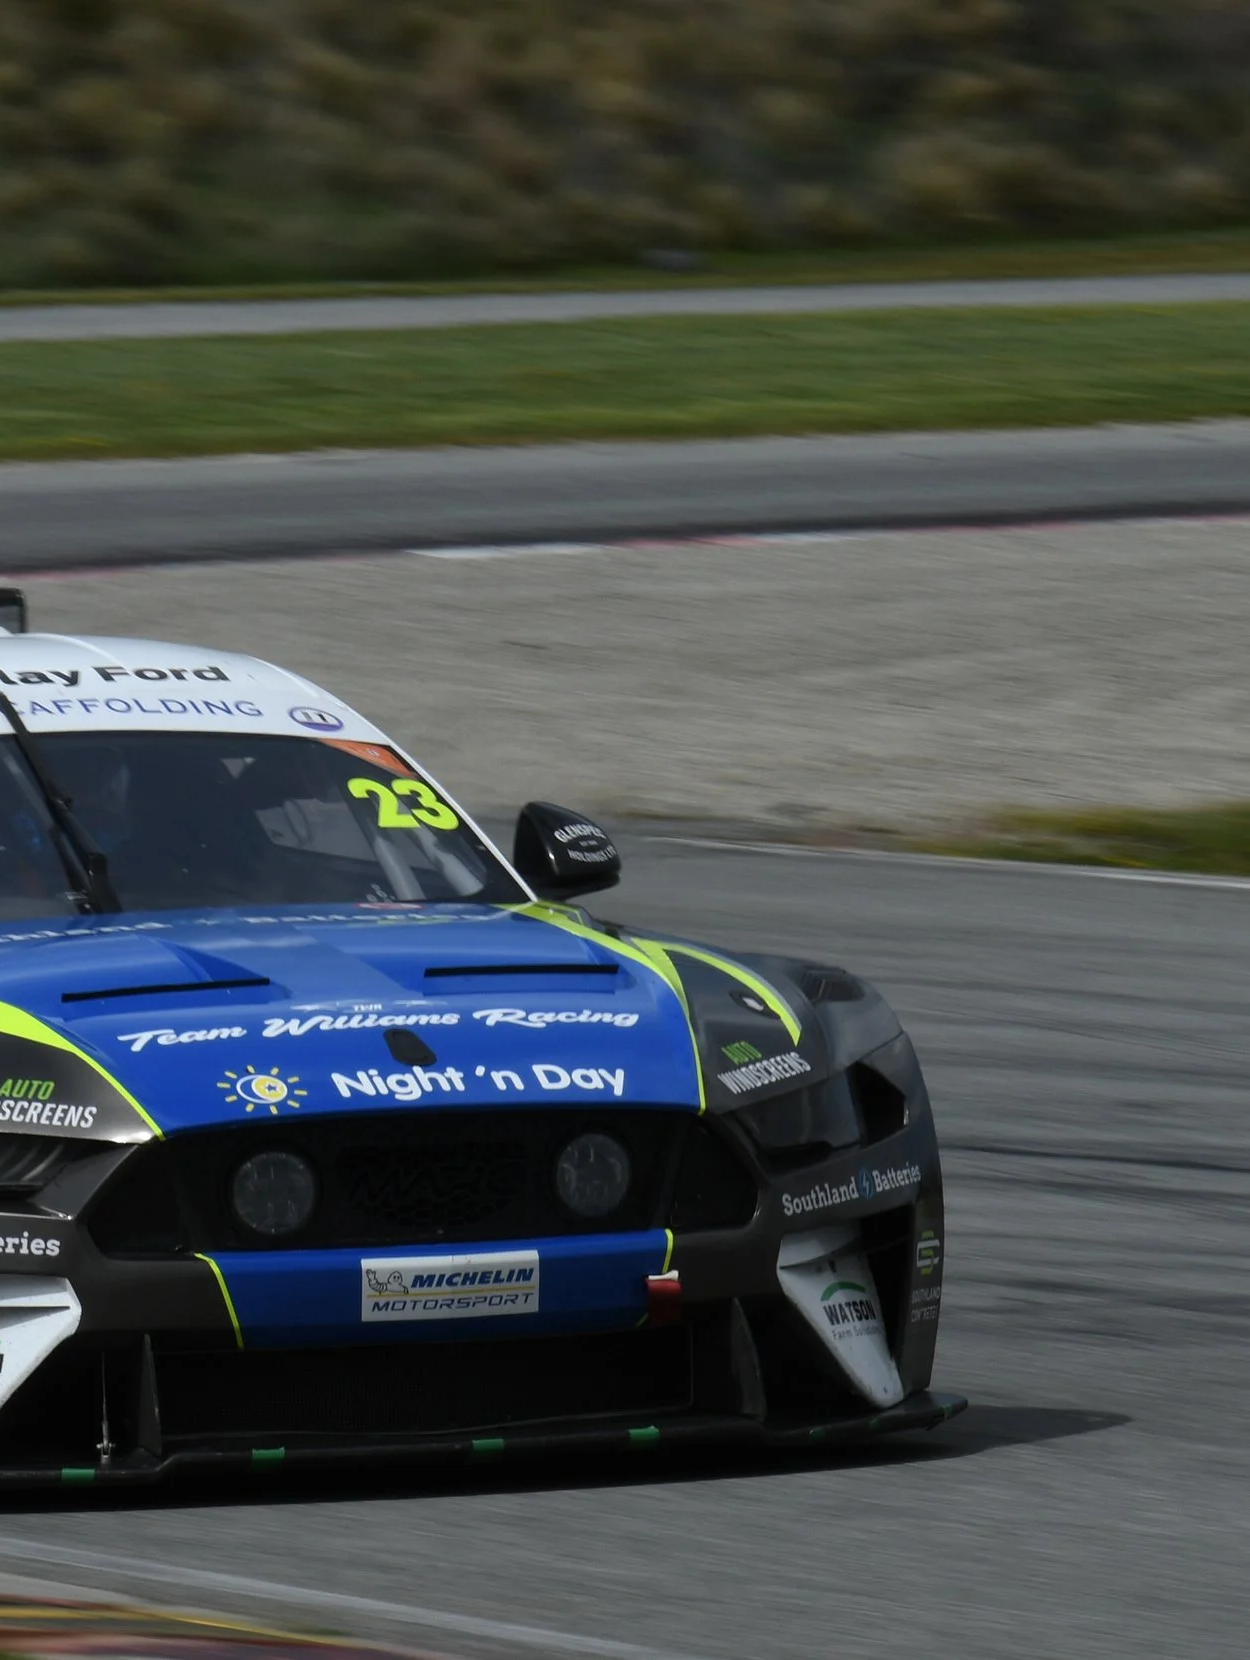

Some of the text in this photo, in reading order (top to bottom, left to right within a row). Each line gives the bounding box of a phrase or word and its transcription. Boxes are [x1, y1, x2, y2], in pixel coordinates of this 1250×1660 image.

[93, 665, 231, 683] Ford
[347, 777, 459, 830] 23
[117, 1008, 640, 1052] Team Williams Racing
[330, 1064, 626, 1101] Night 'n Day
[717, 1051, 811, 1095] WINDSCREENS
[782, 1160, 922, 1216] Southland Batteries
[410, 1267, 535, 1289] MICHELIN
[371, 1292, 535, 1313] MOTORSPORT
[823, 1299, 877, 1326] WATSON
